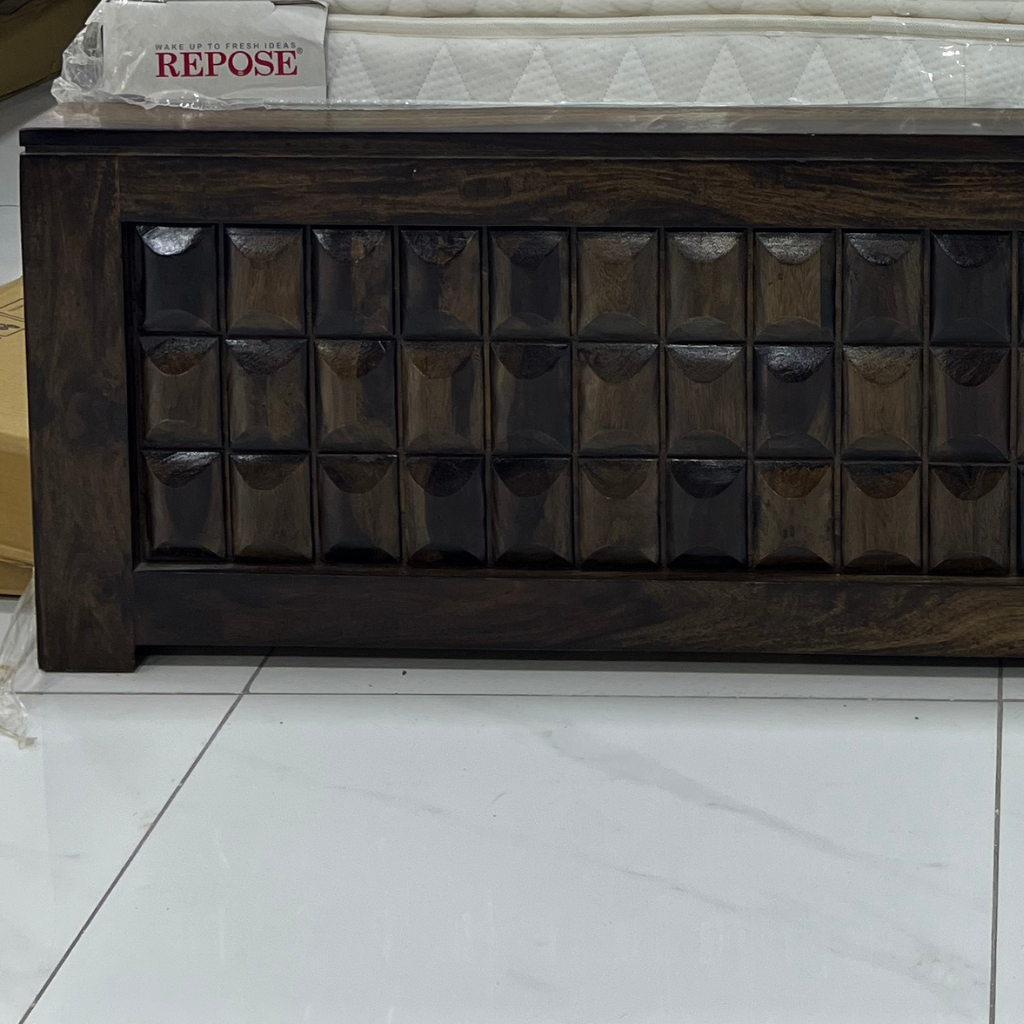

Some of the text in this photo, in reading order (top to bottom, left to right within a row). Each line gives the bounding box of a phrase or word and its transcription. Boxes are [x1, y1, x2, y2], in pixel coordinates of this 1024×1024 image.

[208, 42, 221, 50] TO
[225, 42, 260, 50] FRESH
[264, 41, 297, 49] IDEAS
[155, 50, 298, 78] REPOSE
